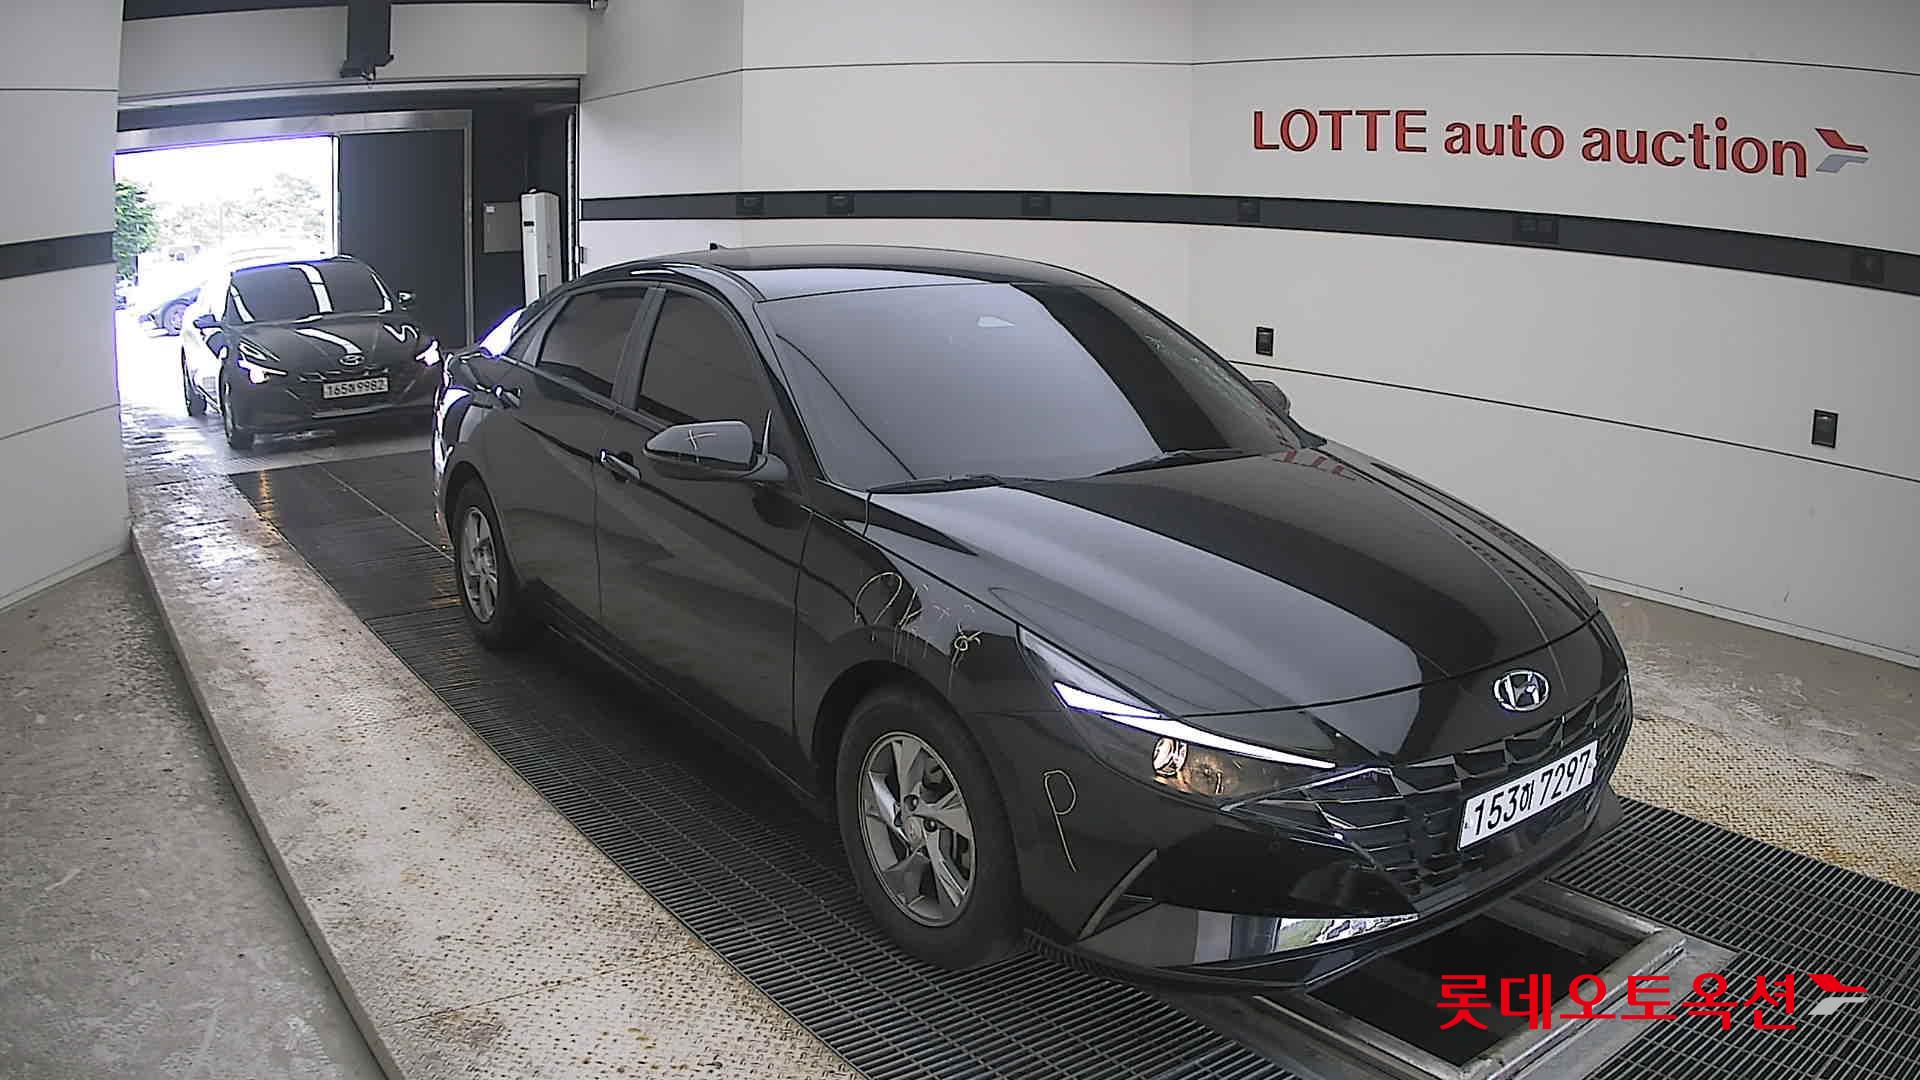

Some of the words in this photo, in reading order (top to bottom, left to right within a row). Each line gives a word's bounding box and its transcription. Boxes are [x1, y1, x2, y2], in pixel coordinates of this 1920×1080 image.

[1253, 110, 1427, 153] LOTTE
[1443, 114, 1565, 159] auto
[1582, 116, 1808, 178] auction
